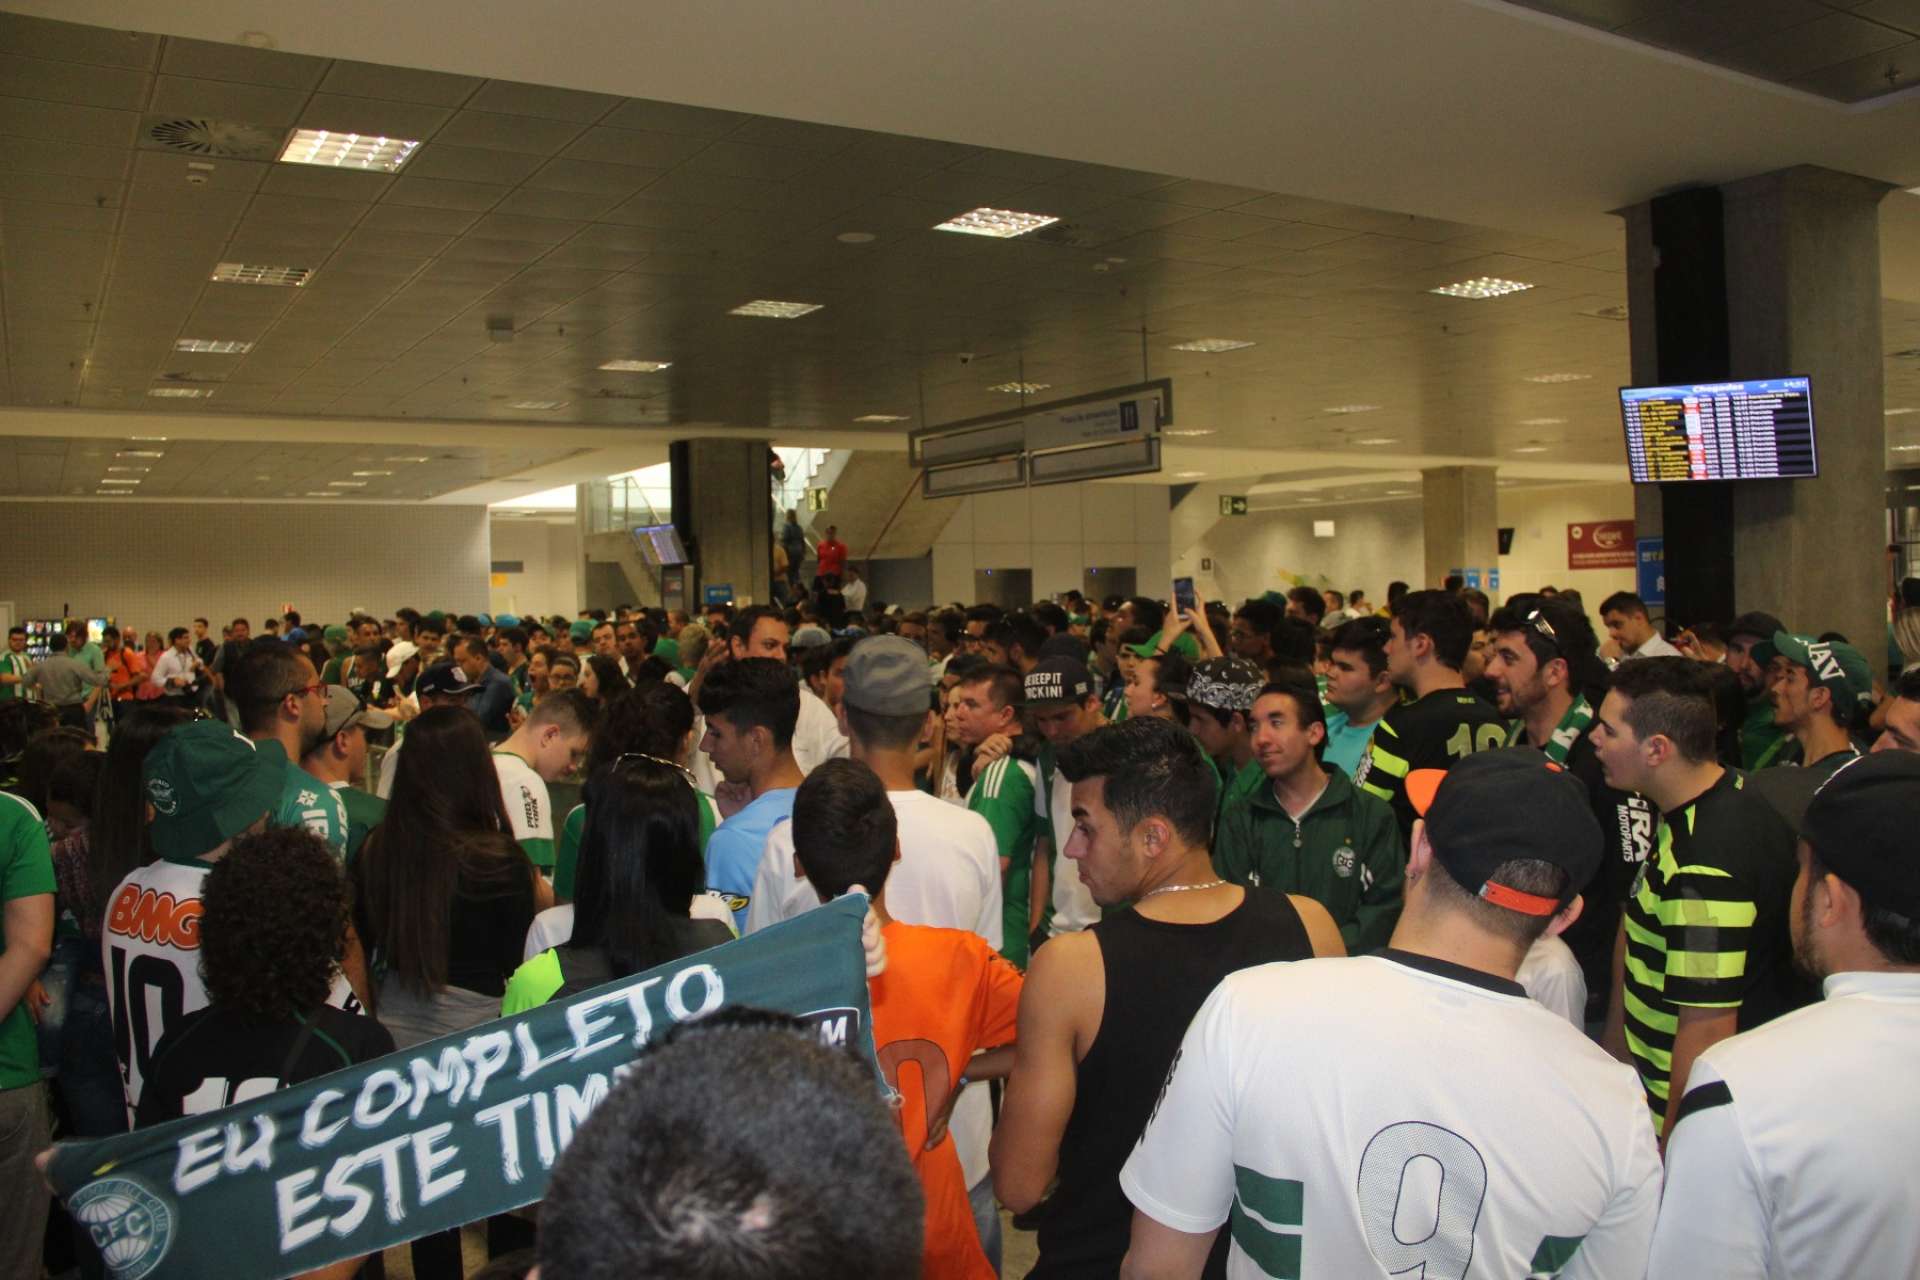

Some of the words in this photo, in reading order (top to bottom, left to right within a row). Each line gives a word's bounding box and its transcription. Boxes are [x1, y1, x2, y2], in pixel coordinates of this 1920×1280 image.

[1053, 672, 1063, 685] IT
[1616, 803, 1635, 863] MOTOPARTS
[173, 1113, 278, 1196] EU
[298, 962, 725, 1151] COMPLETO
[274, 1121, 468, 1256] ESTE
[473, 1058, 645, 1186] TIM
